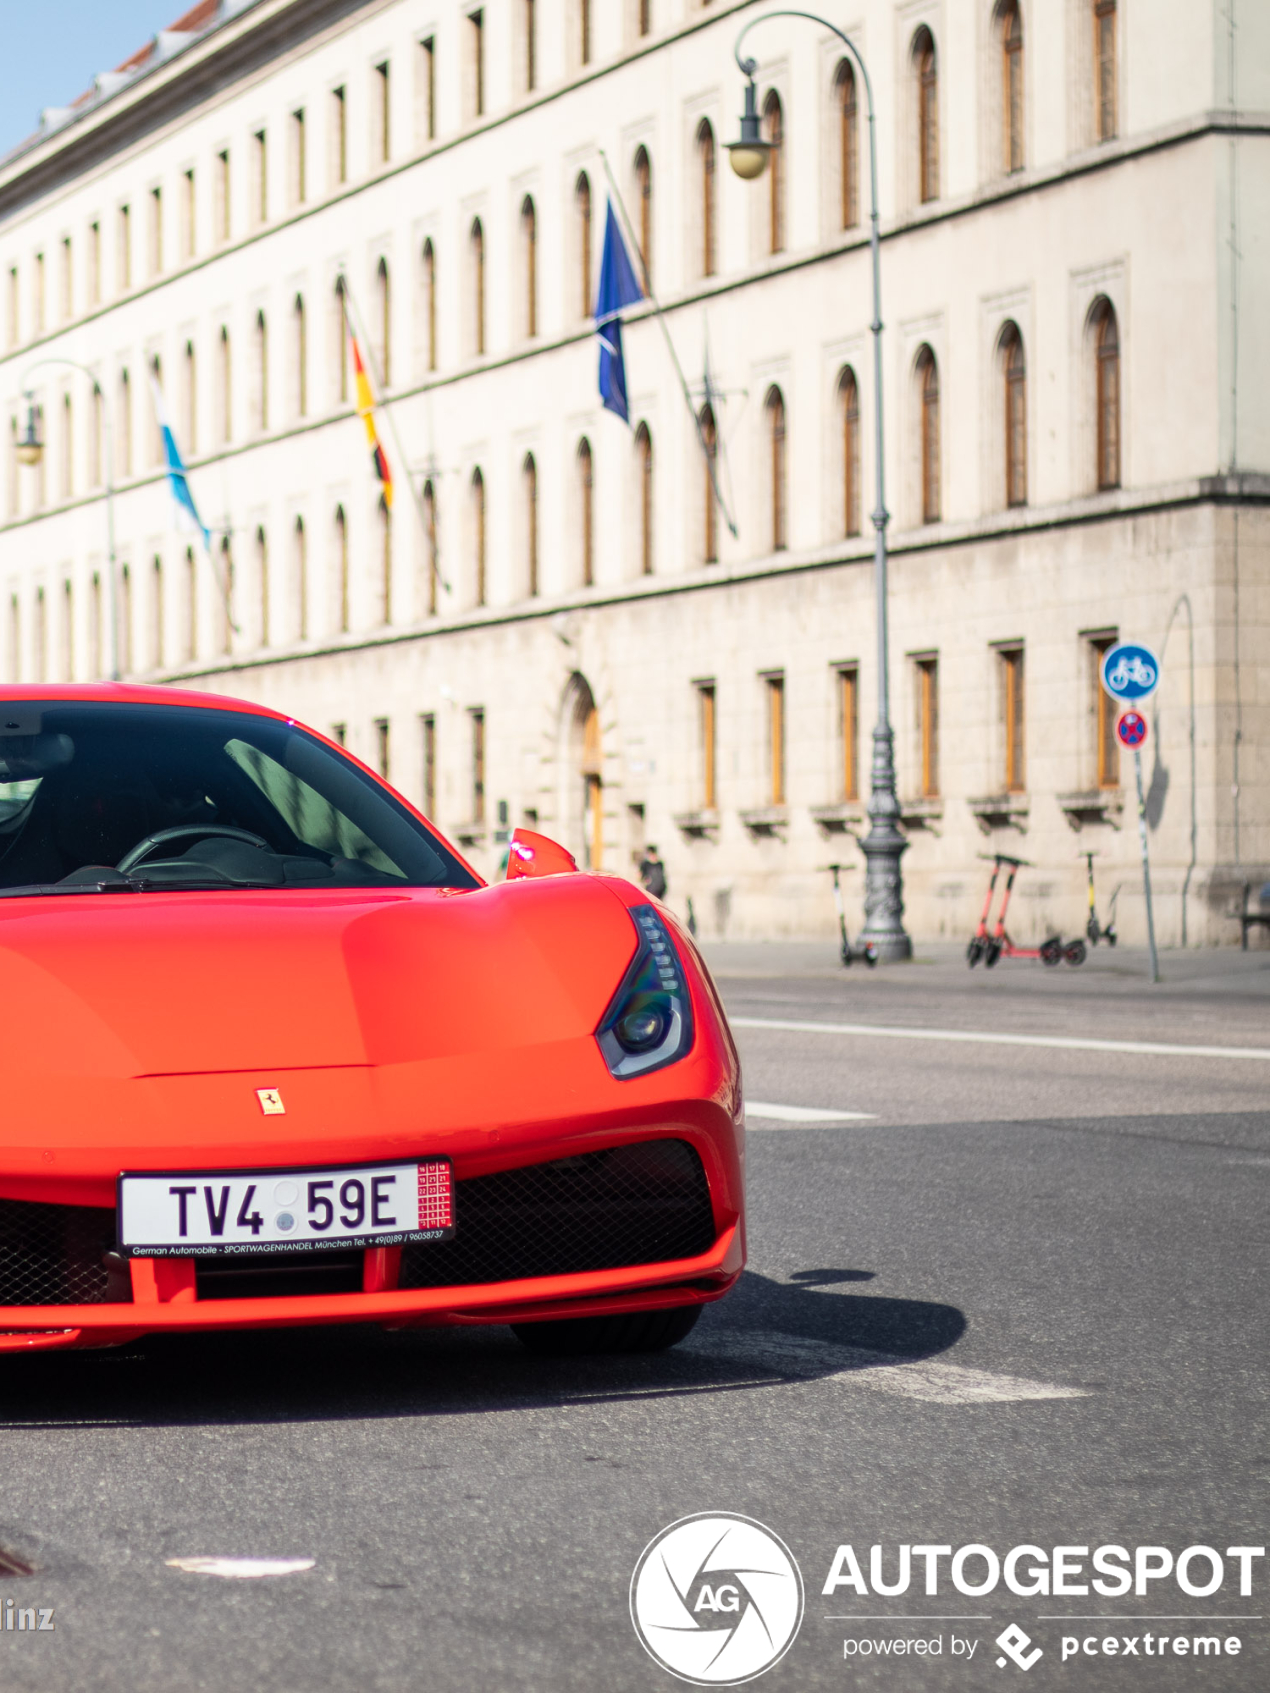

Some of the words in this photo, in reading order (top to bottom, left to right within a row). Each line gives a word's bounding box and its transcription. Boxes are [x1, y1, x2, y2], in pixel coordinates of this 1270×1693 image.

[169, 1185, 263, 1237] TV4
[307, 1175, 397, 1231] 59E
[133, 1247, 167, 1255] German
[169, 1246, 217, 1254] Automobile
[224, 1243, 313, 1253] SPORTWAGENHANDEL
[315, 1239, 351, 1249] München
[354, 1238, 366, 1246] Tel.
[375, 1235, 402, 1245] 49(0)89
[409, 1230, 443, 1241] 96058737
